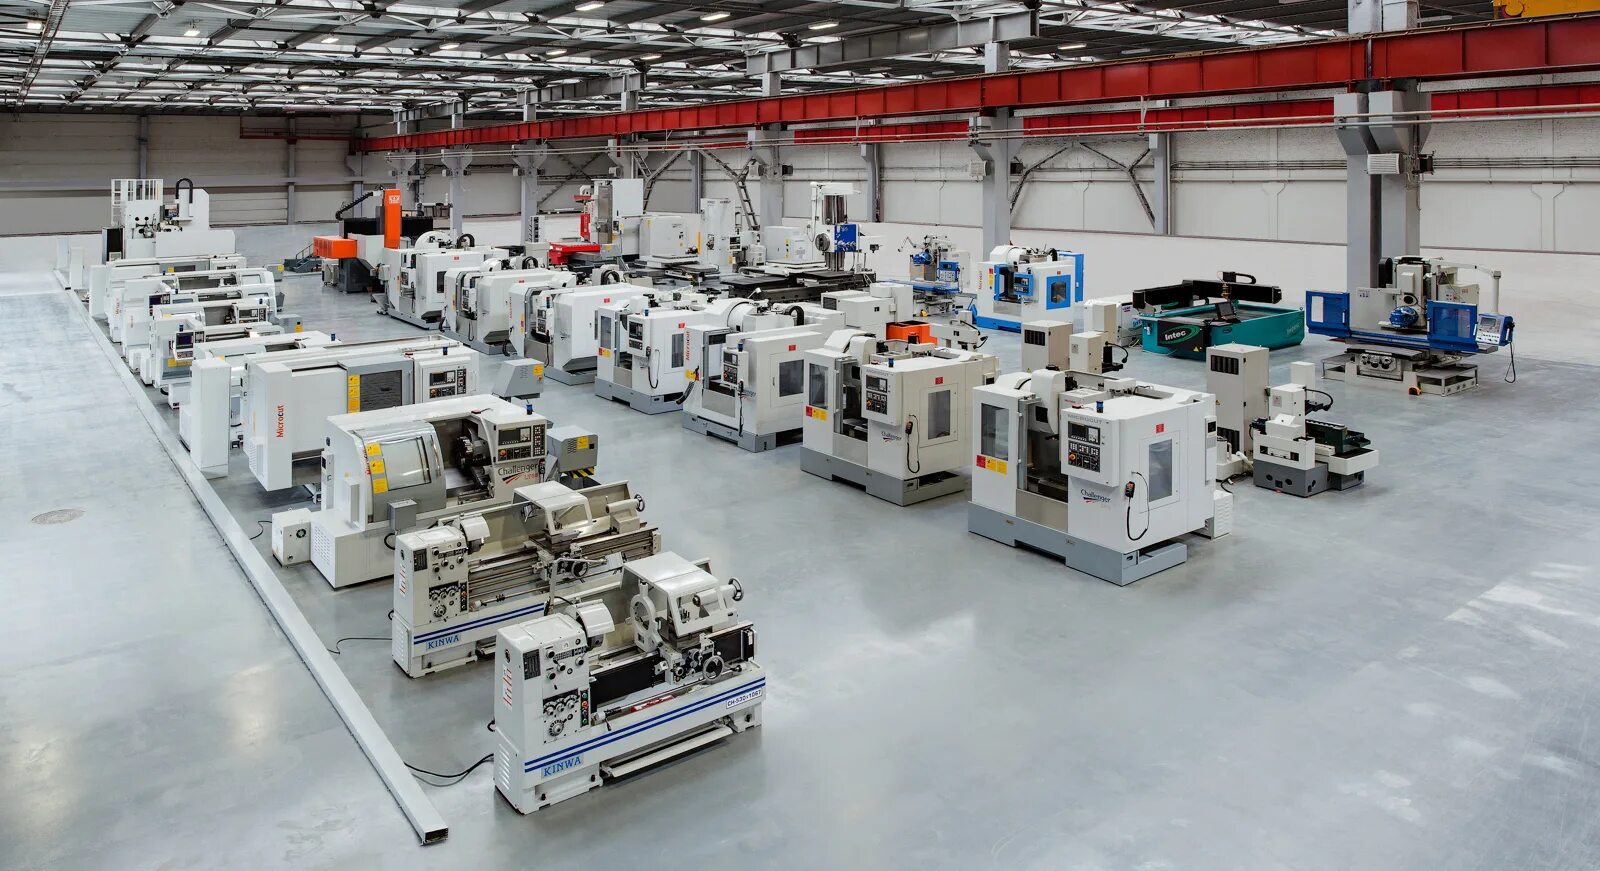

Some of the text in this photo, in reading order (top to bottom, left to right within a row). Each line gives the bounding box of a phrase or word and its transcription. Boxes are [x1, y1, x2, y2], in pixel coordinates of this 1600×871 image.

[1164, 330, 1187, 341] Intec
[276, 404, 284, 438] Microcut
[1067, 413, 1102, 424] MICROCUT
[497, 463, 539, 476] Challenger
[1080, 488, 1111, 503] Challenger
[428, 634, 459, 650] KINWA
[544, 756, 581, 777] KINWA
